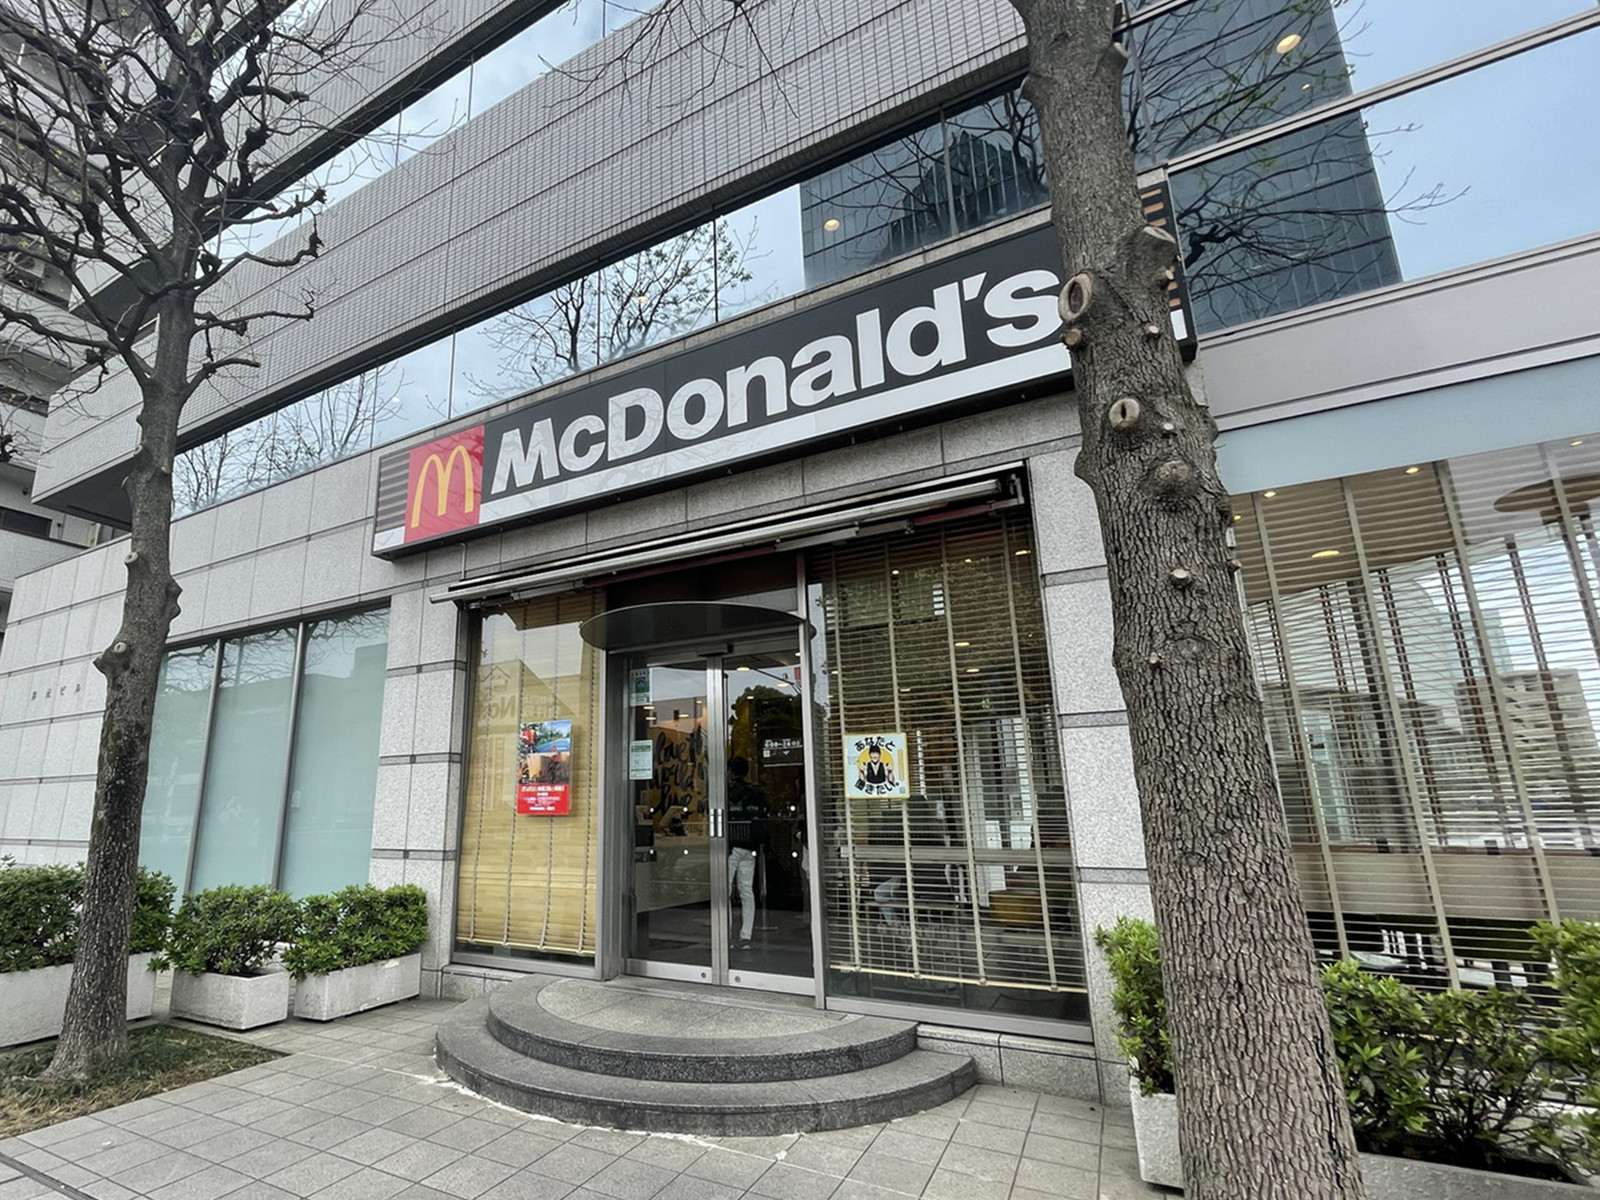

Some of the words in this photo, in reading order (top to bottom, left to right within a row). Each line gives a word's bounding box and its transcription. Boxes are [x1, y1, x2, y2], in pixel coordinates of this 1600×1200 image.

[490, 268, 1063, 495] McDonald's
[854, 736, 896, 752] あなたと
